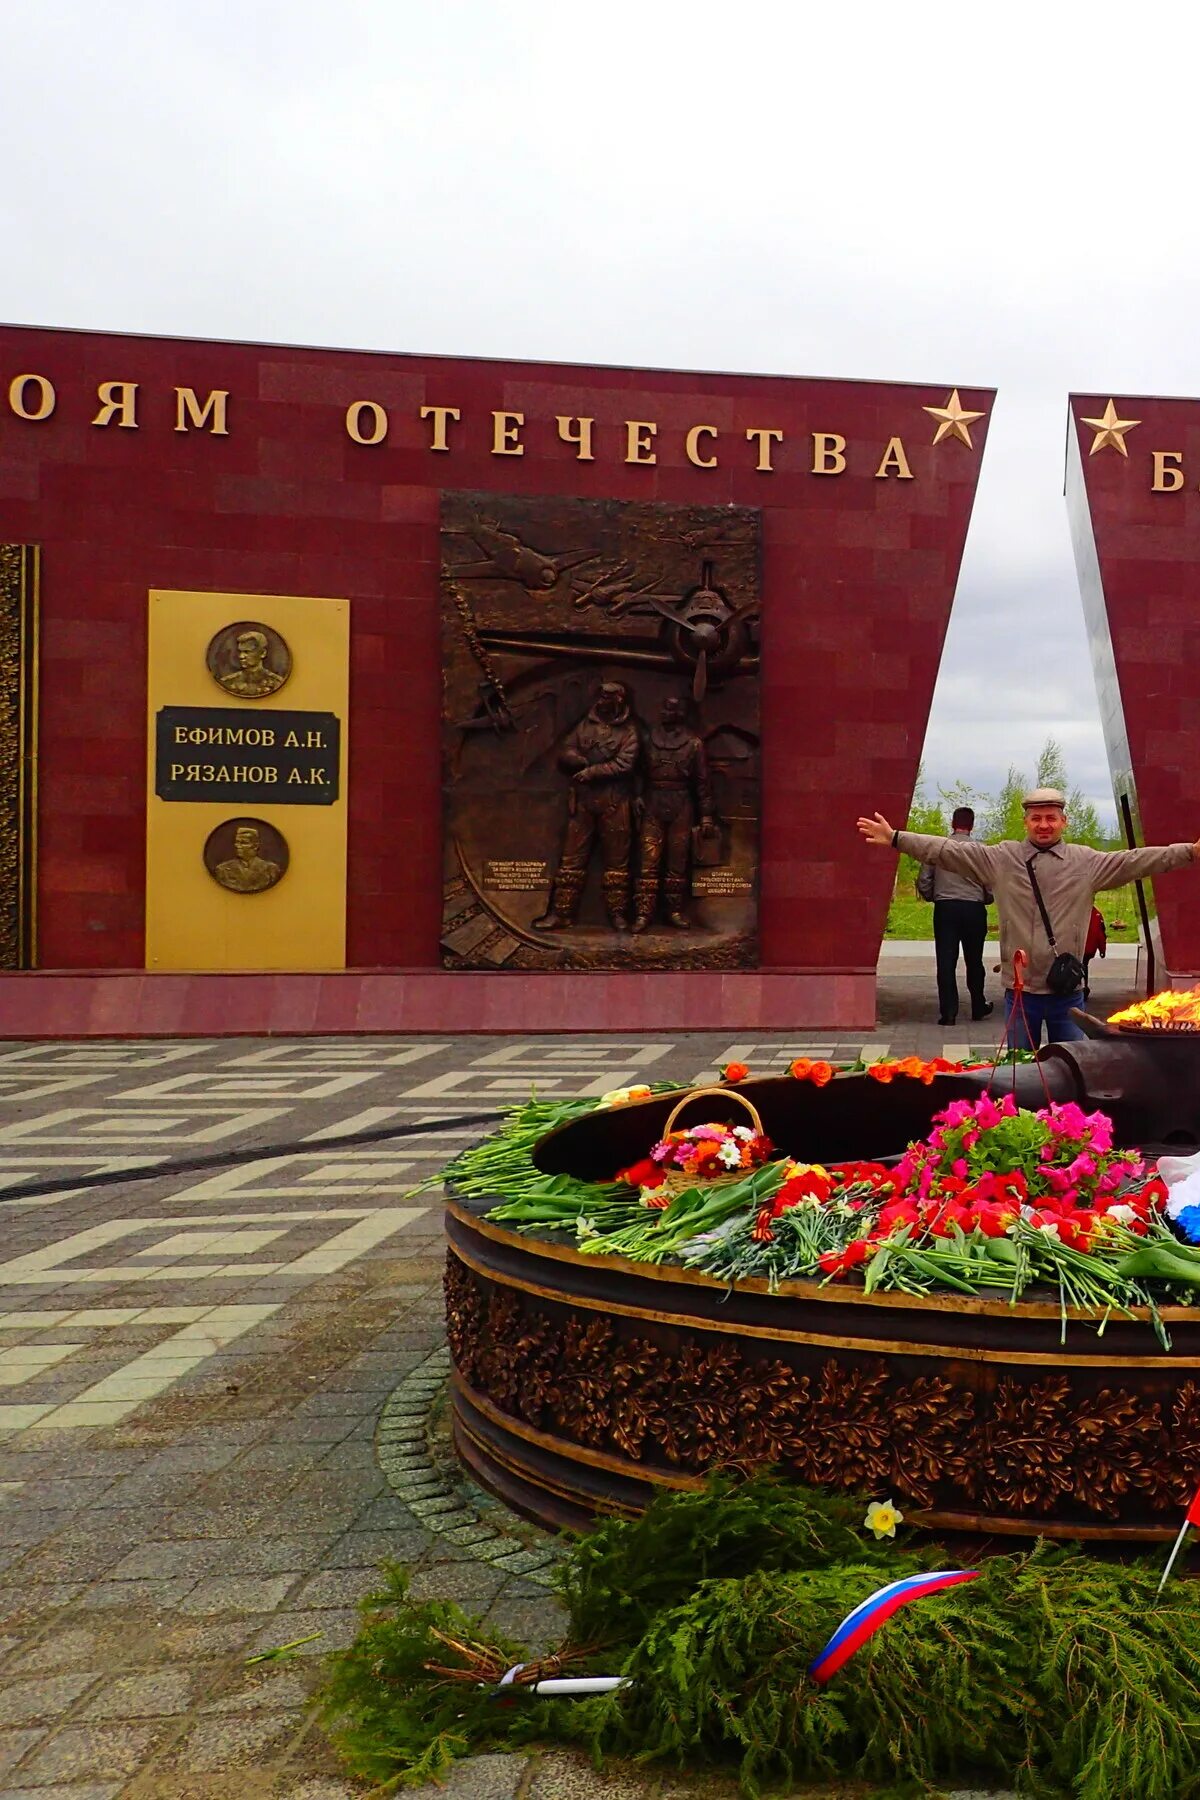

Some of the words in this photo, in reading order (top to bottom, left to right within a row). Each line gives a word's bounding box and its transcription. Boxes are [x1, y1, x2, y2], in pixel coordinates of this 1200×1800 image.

[9, 374, 229, 436] ОЯМ
[346, 400, 914, 479] ОТЕЧЕСТВА
[175, 726, 275, 746] ЕФИМОВ
[284, 730, 328, 748] А.Н.
[171, 764, 278, 783] РЯЗАНОВ
[287, 767, 331, 785] А.К.
